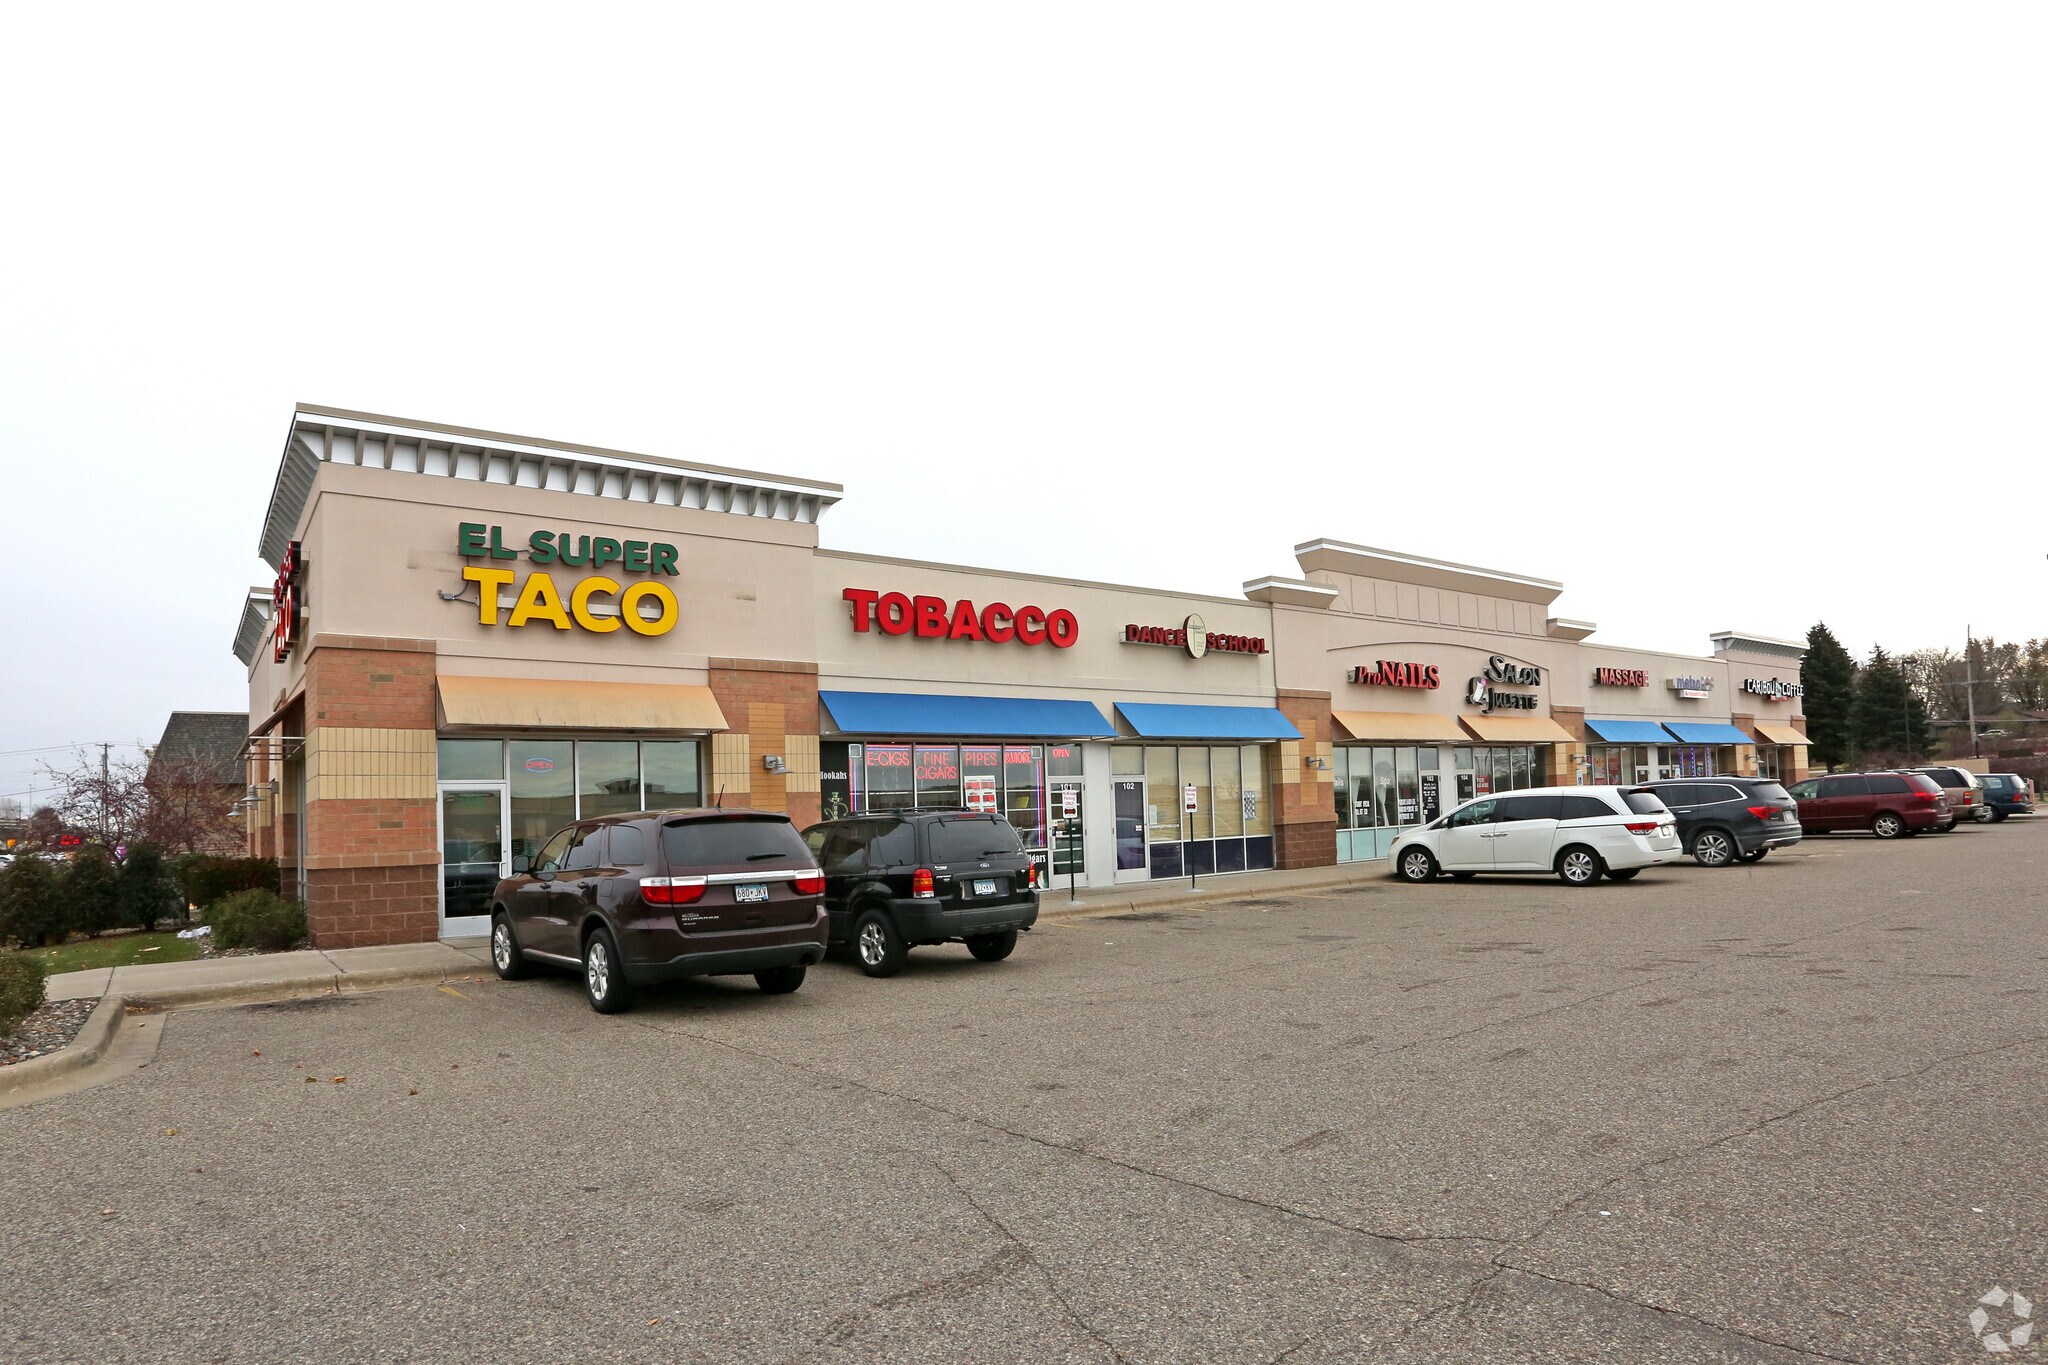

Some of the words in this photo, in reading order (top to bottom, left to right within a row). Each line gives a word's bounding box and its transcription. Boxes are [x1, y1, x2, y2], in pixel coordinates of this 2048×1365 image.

[458, 522, 518, 560] EL
[529, 530, 680, 576] SUPER
[462, 566, 679, 637] TACO
[843, 588, 1079, 648] TOBACCO
[1125, 624, 1187, 647] DANCE
[1205, 632, 1269, 654] SCHOOL
[1597, 667, 1649, 687] MASSAGE
[1747, 679, 1775, 695] CARIBOU
[1782, 681, 1804, 697] COFFEE
[867, 752, 910, 767] E-CIGS
[923, 752, 949, 766] FINE
[965, 752, 998, 767] PIPES
[1052, 748, 1070, 758] OPEN
[525, 761, 554, 769] OPEN
[916, 766, 957, 780] CIGARS
[1060, 783, 1072, 791] 101
[737, 888, 750, 898] 680
